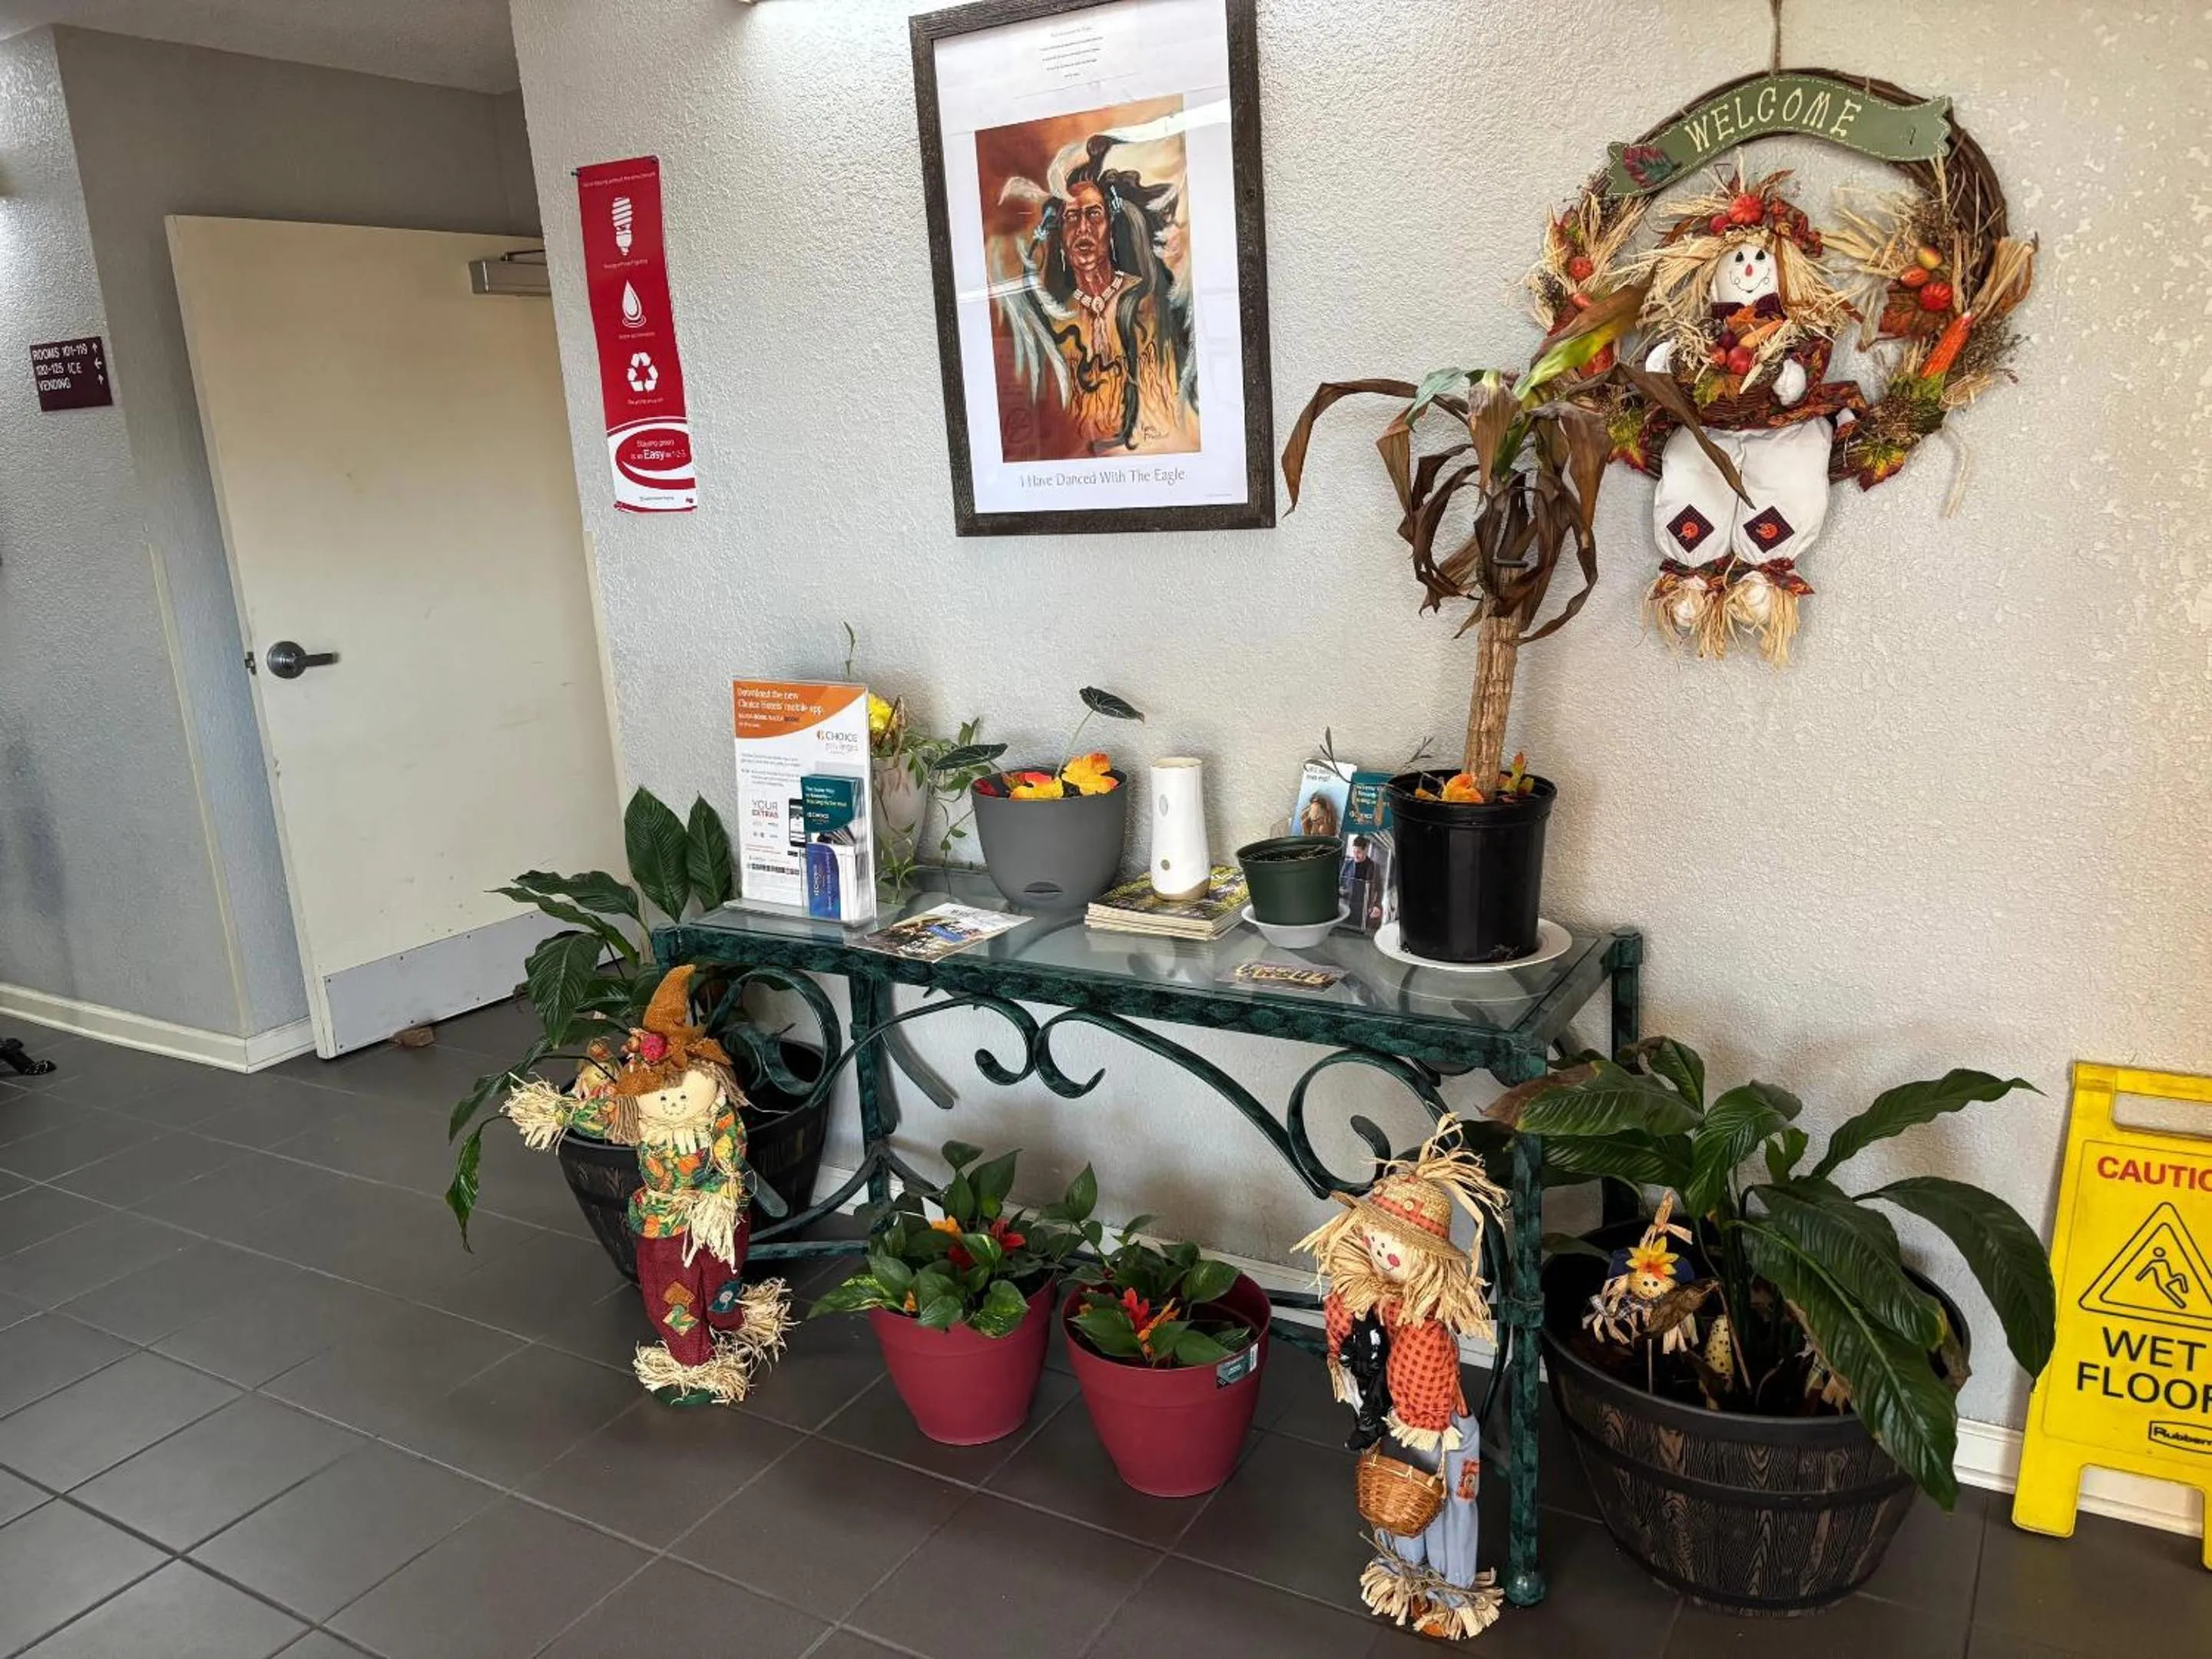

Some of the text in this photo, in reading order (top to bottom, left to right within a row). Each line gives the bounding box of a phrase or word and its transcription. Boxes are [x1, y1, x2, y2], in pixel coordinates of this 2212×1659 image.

[1684, 86, 1862, 153] WELCOME
[32, 346, 60, 360] ROOMS
[36, 362, 82, 376] 120-125 ICE
[38, 377, 71, 392] VENDING
[643, 449, 665, 461] Easy
[1028, 472, 1053, 488] Have
[1056, 471, 1097, 486] Danced
[1099, 469, 1126, 484] With
[1128, 469, 1151, 483] The
[1154, 466, 1186, 486] Eagle
[784, 692, 800, 700] new
[825, 730, 858, 743] CHOICE
[751, 800, 778, 811] YOUR
[751, 809, 780, 819] EXTRAS
[2102, 1326, 2207, 1372] WET
